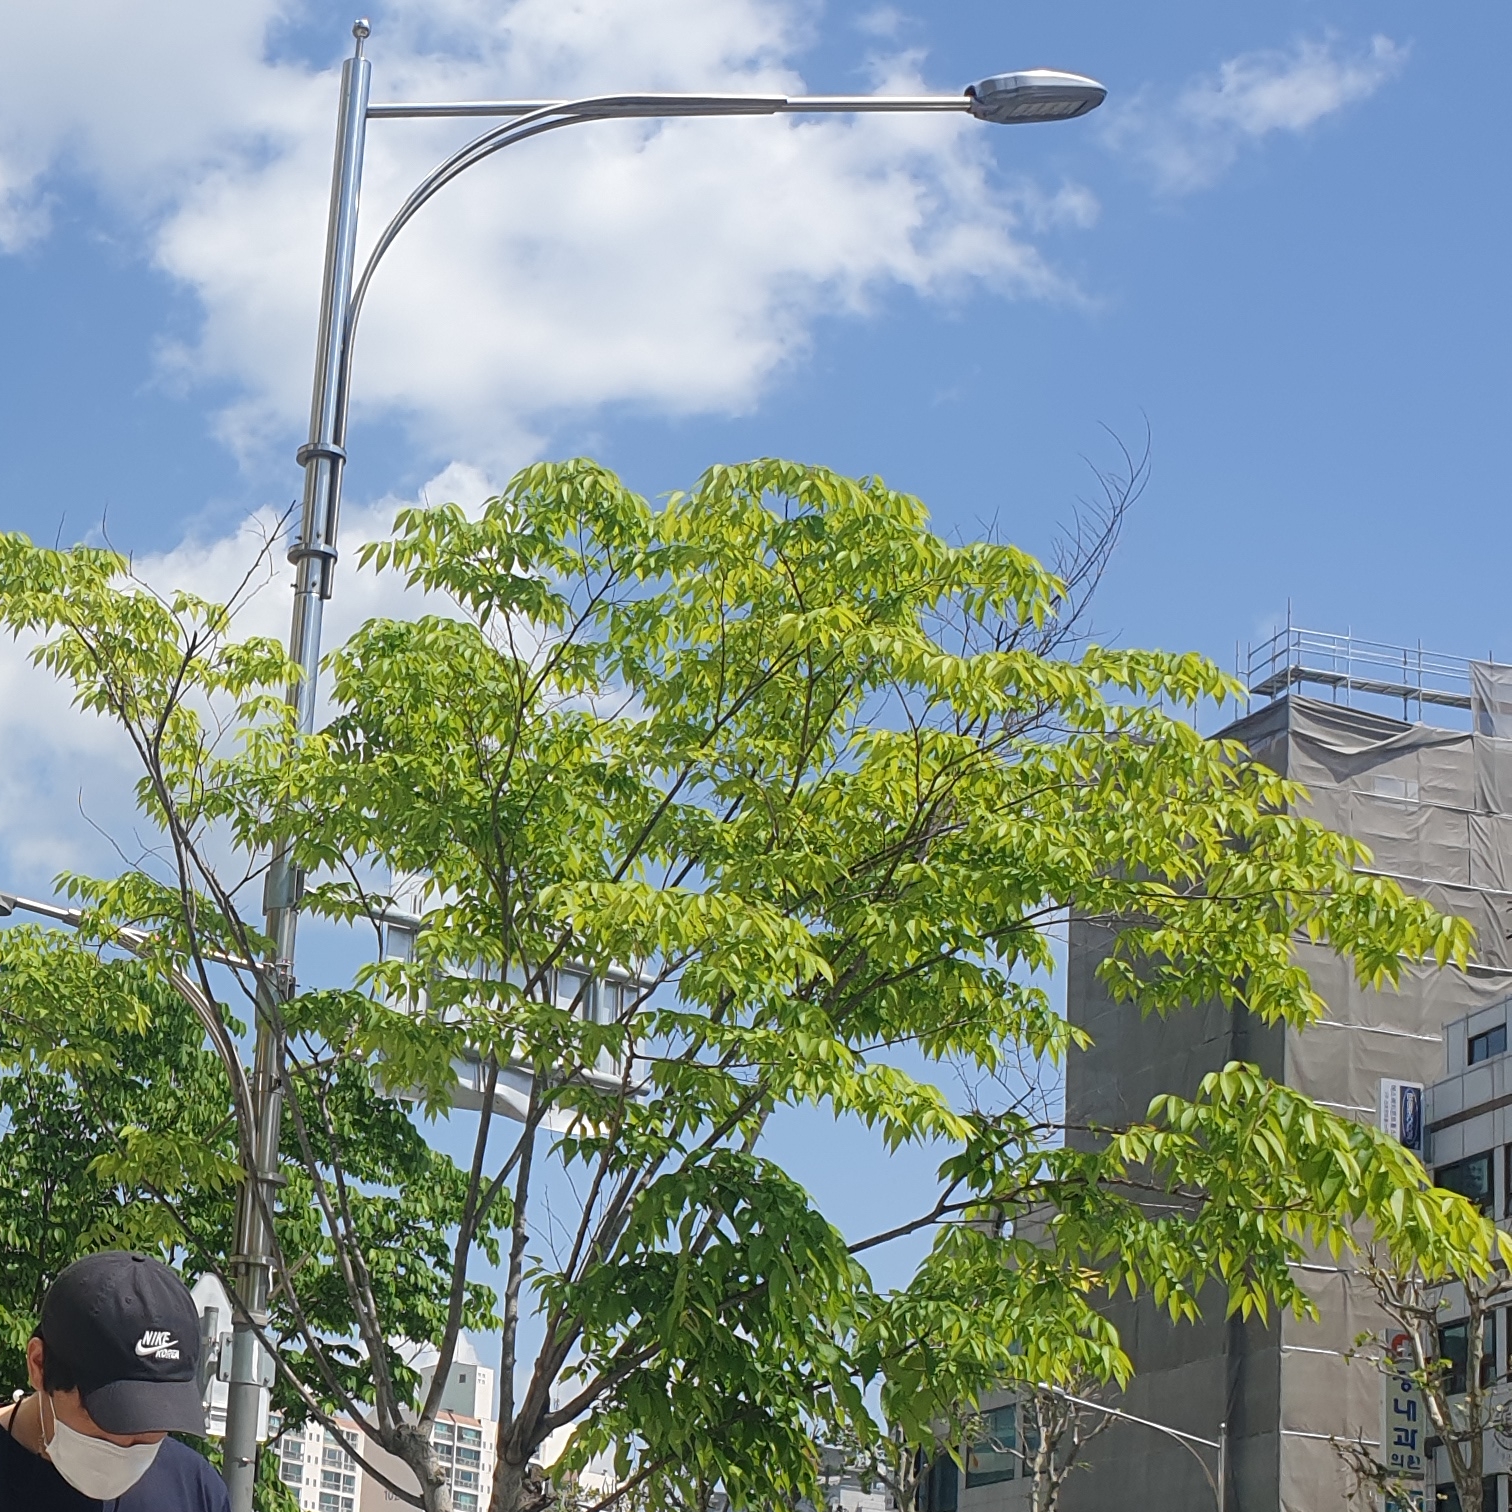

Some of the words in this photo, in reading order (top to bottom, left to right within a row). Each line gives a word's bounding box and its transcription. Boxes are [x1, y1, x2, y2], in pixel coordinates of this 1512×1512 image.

[142, 1330, 171, 1346] NIKE
[155, 1348, 180, 1360] KOREA
[1391, 1452, 1421, 1470] 의원
